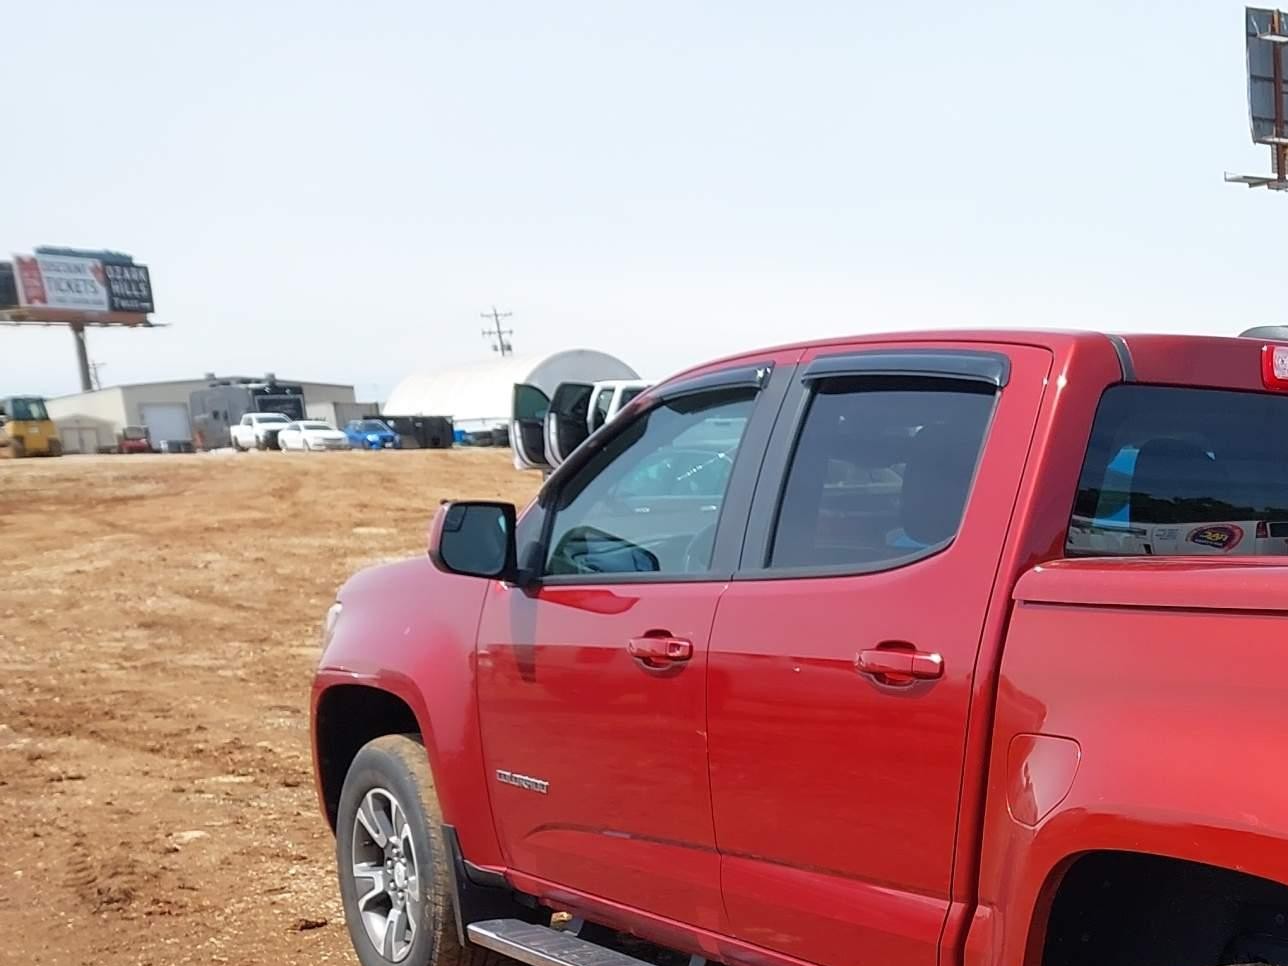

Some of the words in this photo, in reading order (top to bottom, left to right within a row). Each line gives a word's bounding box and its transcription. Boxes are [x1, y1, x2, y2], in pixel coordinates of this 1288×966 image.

[105, 264, 147, 281] OZARK
[46, 276, 99, 295] TICKETS
[110, 278, 149, 299] HILLS
